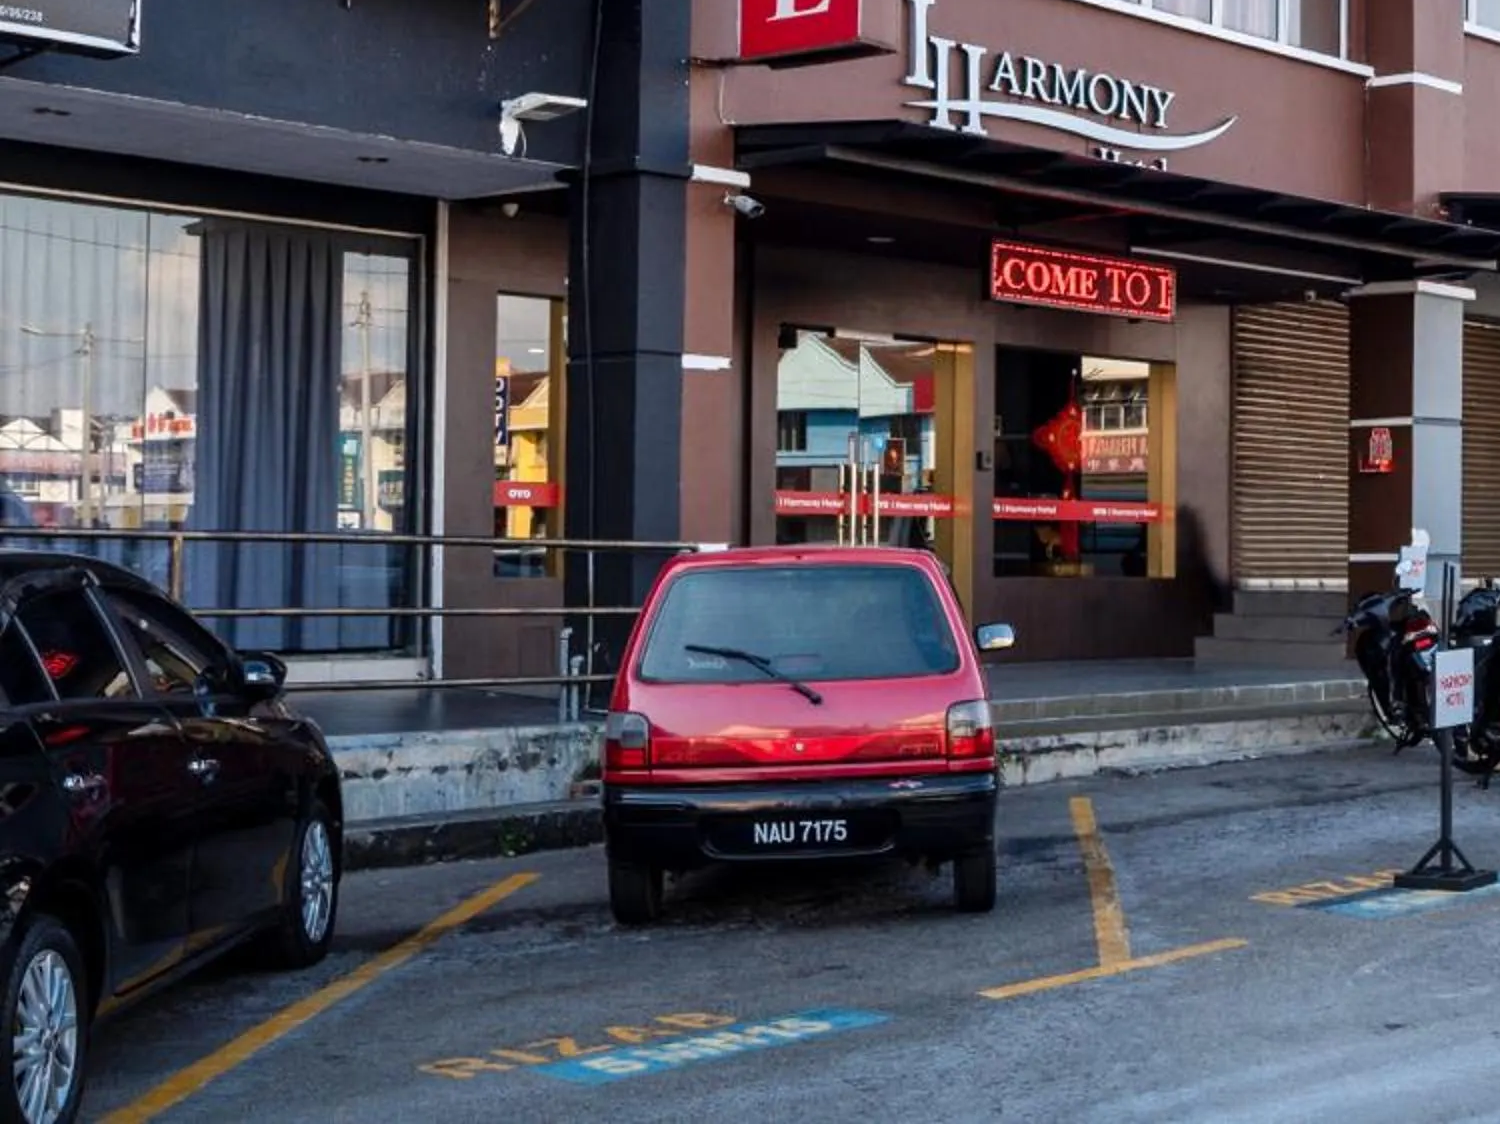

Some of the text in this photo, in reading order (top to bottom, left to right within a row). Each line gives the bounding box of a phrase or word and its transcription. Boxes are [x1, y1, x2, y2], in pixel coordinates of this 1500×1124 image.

[995, 258, 1099, 300] COME
[1106, 267, 1151, 306] TO
[753, 820, 848, 844] NAU 7175
